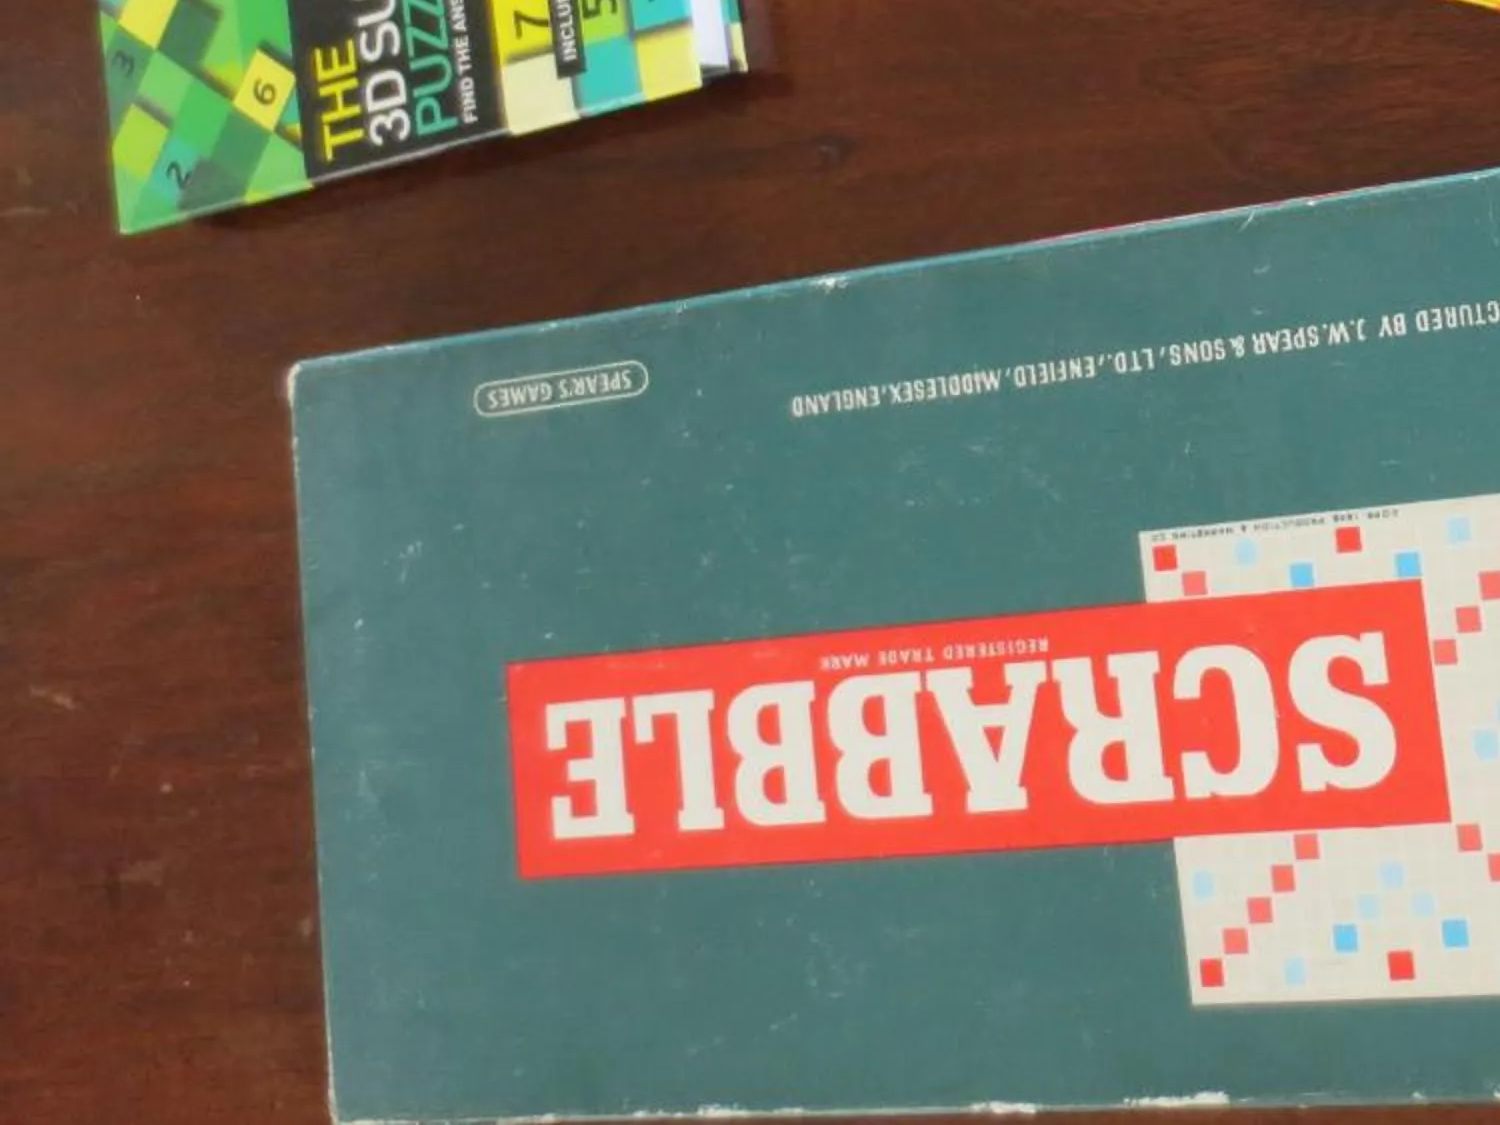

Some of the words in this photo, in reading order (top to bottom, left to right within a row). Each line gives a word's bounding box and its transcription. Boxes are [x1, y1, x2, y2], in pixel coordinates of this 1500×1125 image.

[514, 11, 548, 39] 7
[454, 33, 472, 74] THE
[252, 80, 277, 106] 6
[315, 44, 360, 159] THE
[363, 65, 411, 147] 3D
[459, 75, 478, 123] FIND
[1375, 311, 1407, 338] BY
[1229, 334, 1246, 357] &
[486, 380, 552, 409] GAMES
[557, 368, 632, 398] SPEAR'S
[818, 650, 869, 671] MARK
[878, 645, 934, 666] TRADE
[942, 634, 1048, 660] REGISTERED
[546, 630, 1400, 840] SCRABBLE
